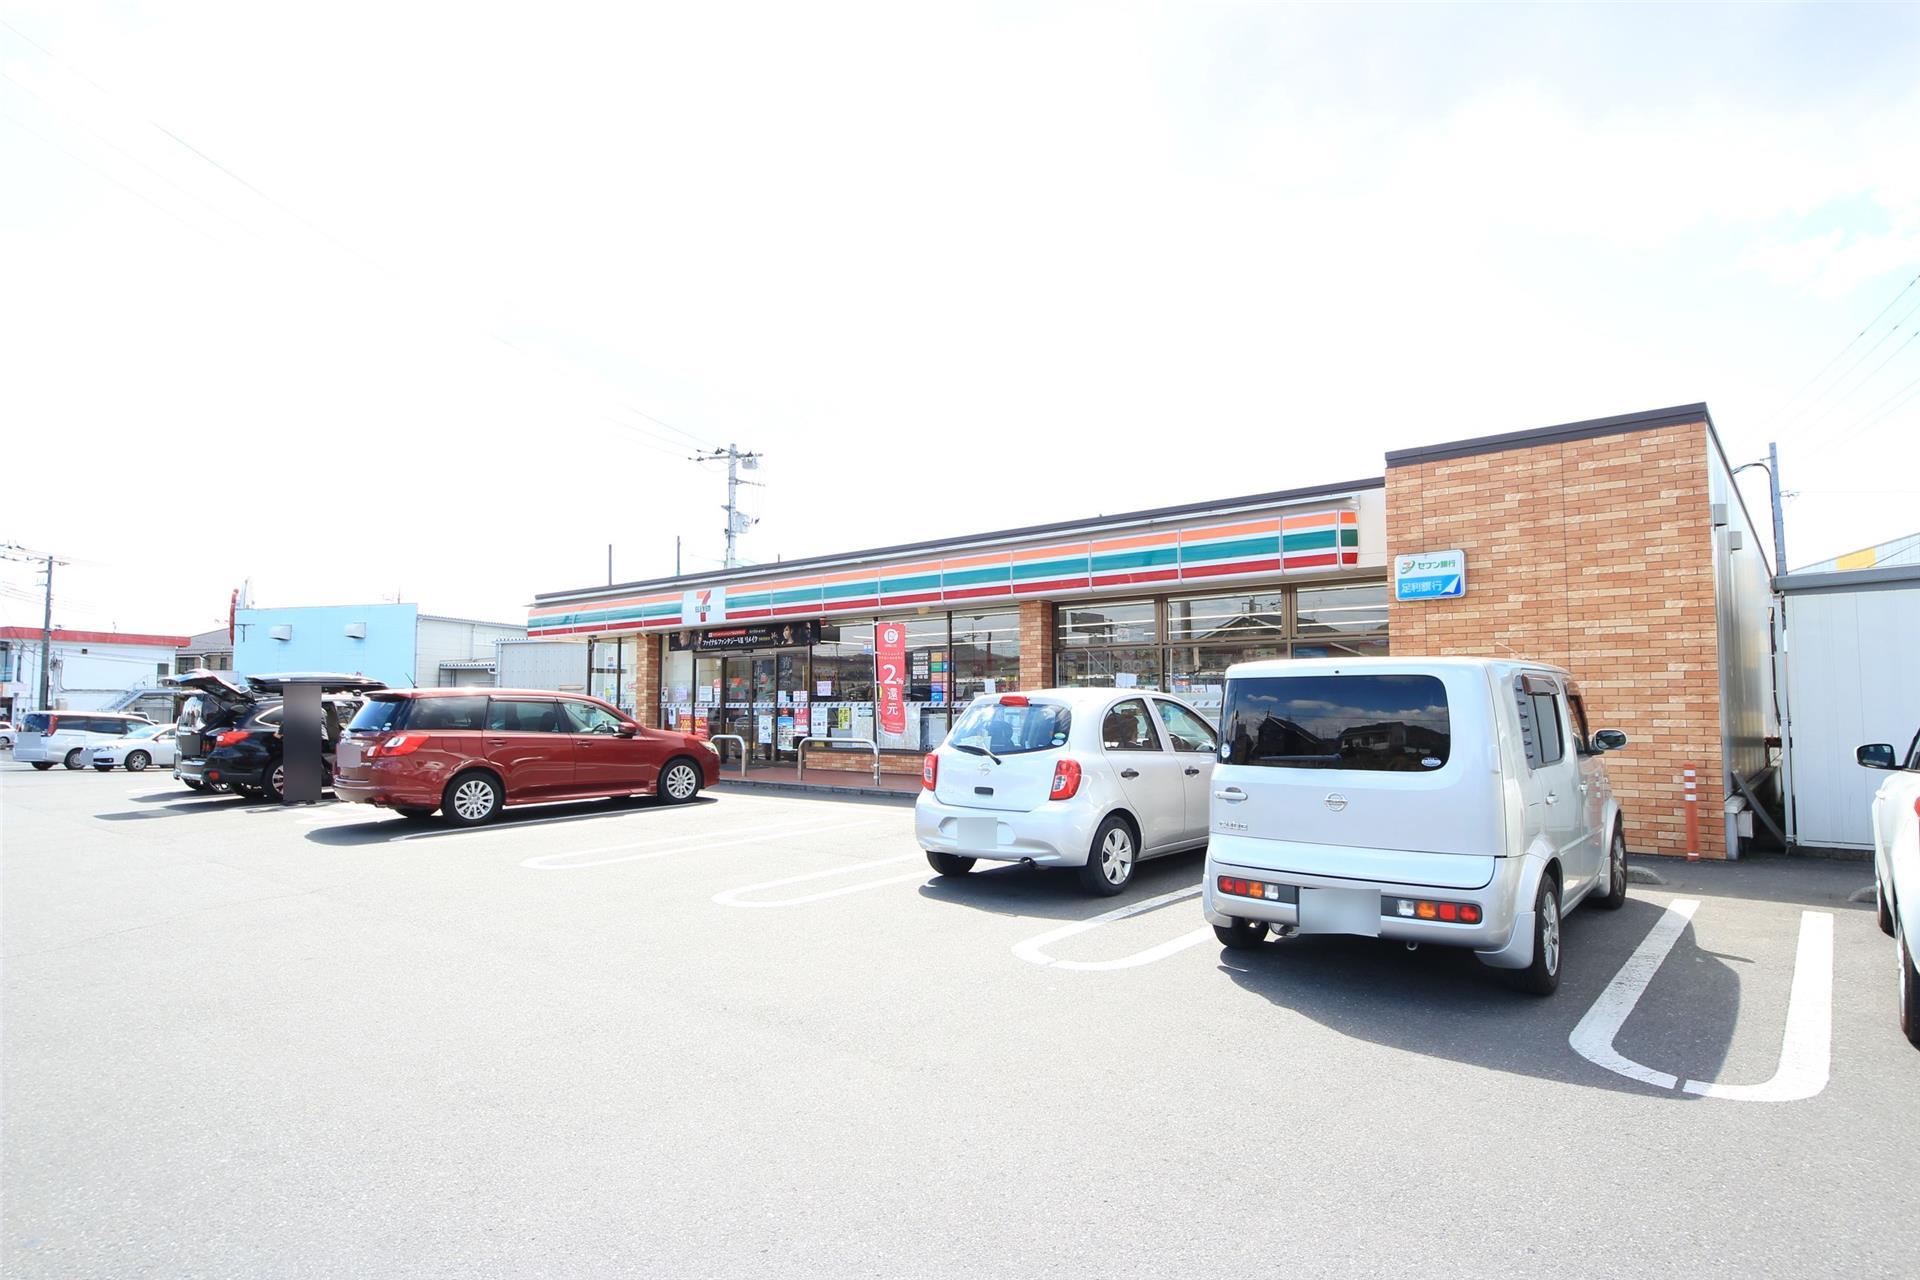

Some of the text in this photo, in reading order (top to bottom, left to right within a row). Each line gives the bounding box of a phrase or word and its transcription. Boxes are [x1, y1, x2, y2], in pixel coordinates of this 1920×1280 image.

[1418, 560, 1456, 570] セブン銀行
[1401, 580, 1443, 593] 足利銀行
[696, 590, 711, 622] 7
